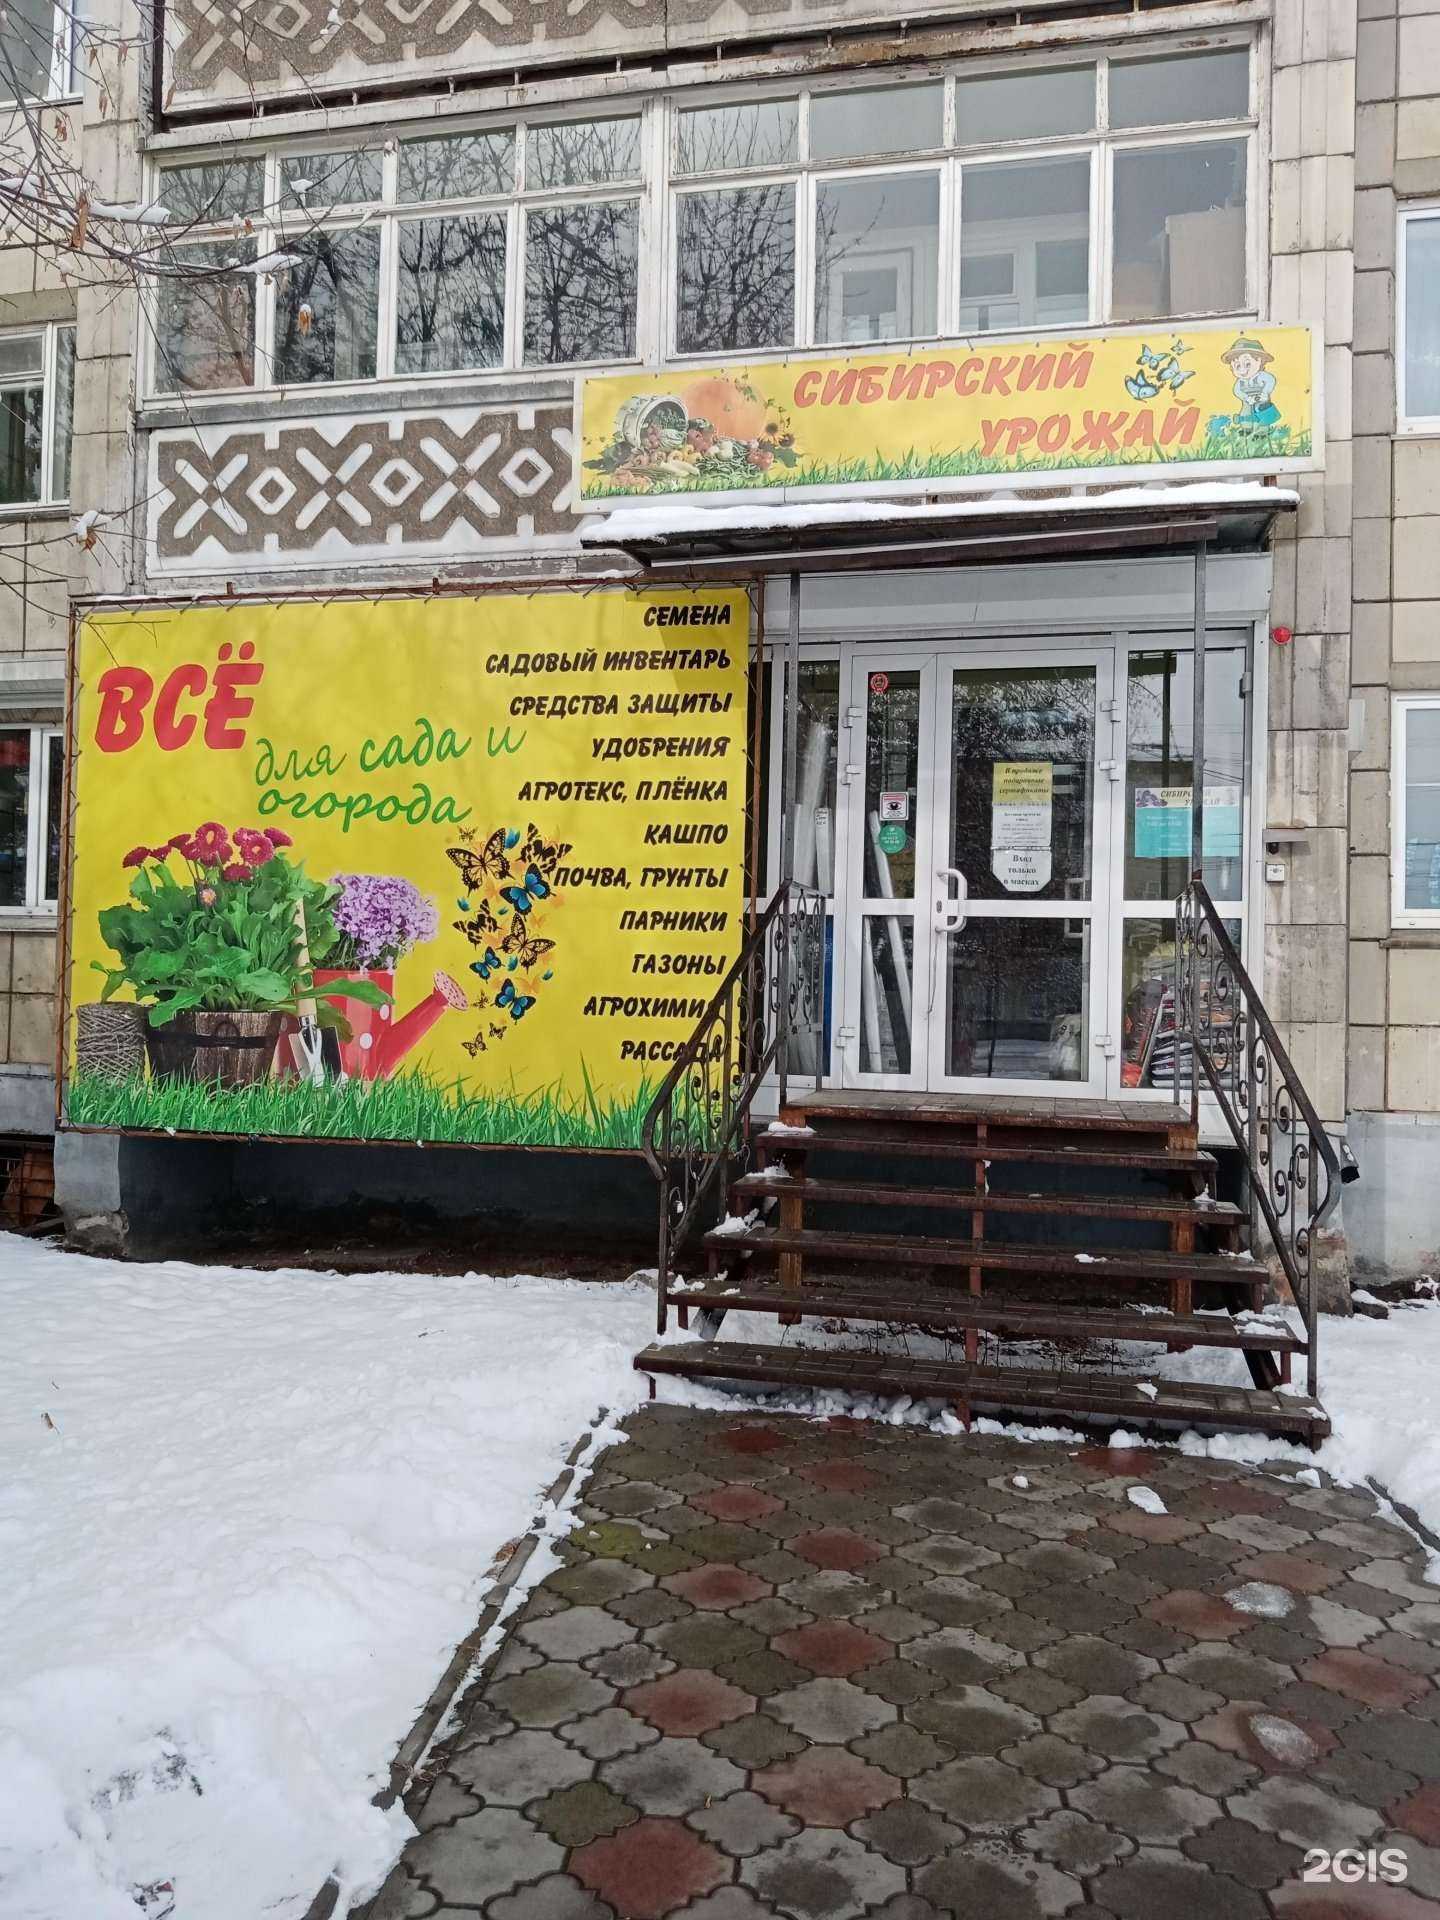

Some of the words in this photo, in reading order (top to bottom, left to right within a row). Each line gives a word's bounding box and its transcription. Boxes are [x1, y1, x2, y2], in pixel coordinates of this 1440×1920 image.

[793, 343, 1094, 408] СИБИРСКИЙ
[980, 399, 1200, 458] УРОЖАЙ
[643, 603, 731, 627] СЕМЕНА
[485, 647, 597, 677] САДОВЫЙ
[602, 647, 732, 673] ИНВЕНТАРЬ
[94, 641, 264, 753] ВСЁ
[509, 694, 619, 720] СРЕДСТВА
[627, 692, 732, 717] ЗАЩИТЫ
[256, 738, 347, 786] для
[360, 718, 472, 772] сада
[487, 726, 527, 757] и
[592, 736, 731, 761] УДОБРЕНИЯ
[517, 780, 628, 805] АГРОТЕКС,
[635, 774, 728, 802] ПЛЁНКА
[258, 783, 472, 833] огорода
[643, 823, 729, 846] КАШПО
[553, 867, 631, 890] ПОЧВА,
[640, 867, 729, 888] ГРУНТЫ
[619, 910, 728, 933] ПАРНИКИ
[631, 953, 727, 975] ГАЗОНЫ
[583, 996, 722, 1019] АГРОХИМИ
